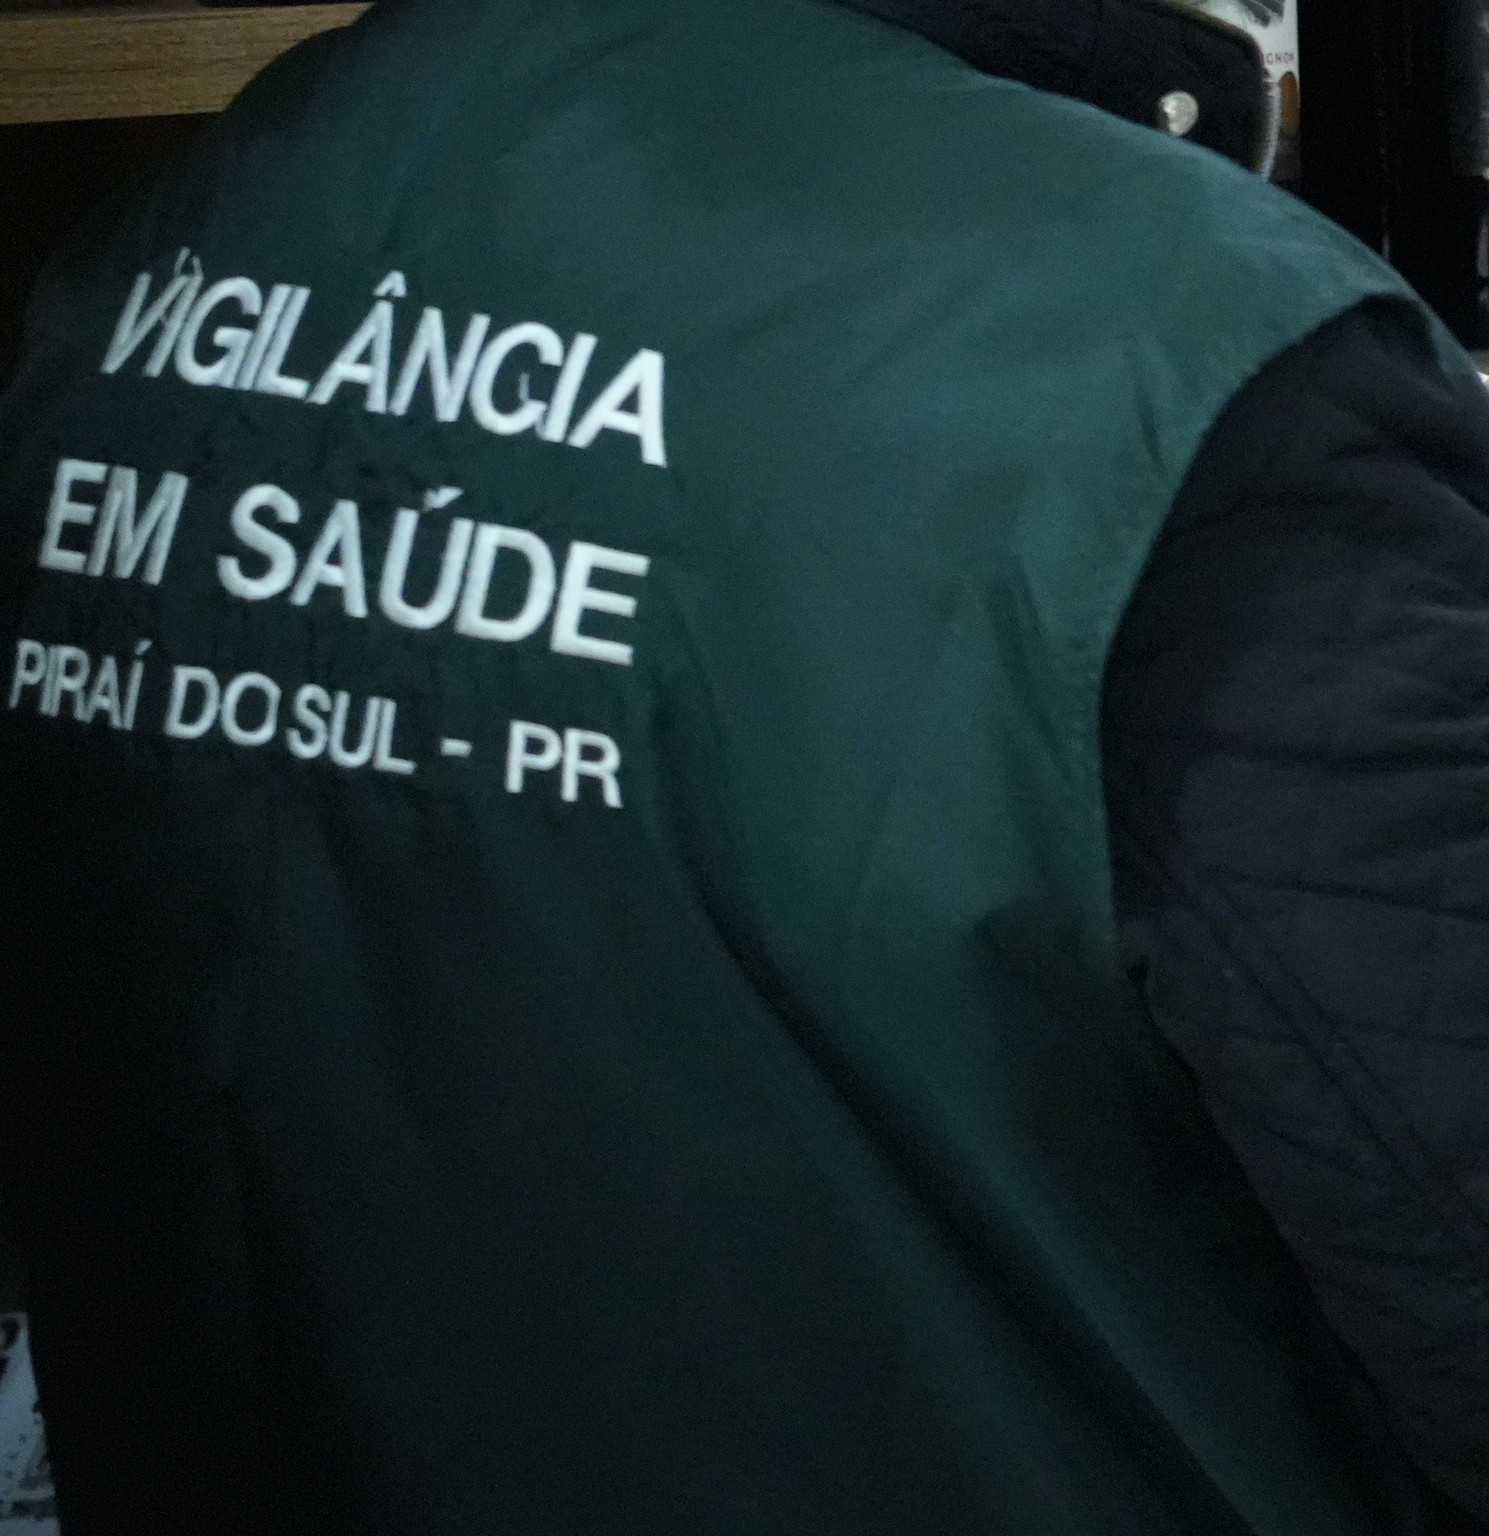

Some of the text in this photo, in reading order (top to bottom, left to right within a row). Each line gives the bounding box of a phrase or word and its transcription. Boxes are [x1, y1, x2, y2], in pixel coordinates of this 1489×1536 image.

[101, 246, 667, 467] VIGILÂNCIA
[38, 458, 651, 666] EM SAÚDE
[9, 637, 152, 730] PIRAÍ
[165, 665, 282, 747] DO
[286, 682, 417, 775] SUL
[505, 719, 623, 808] PR
